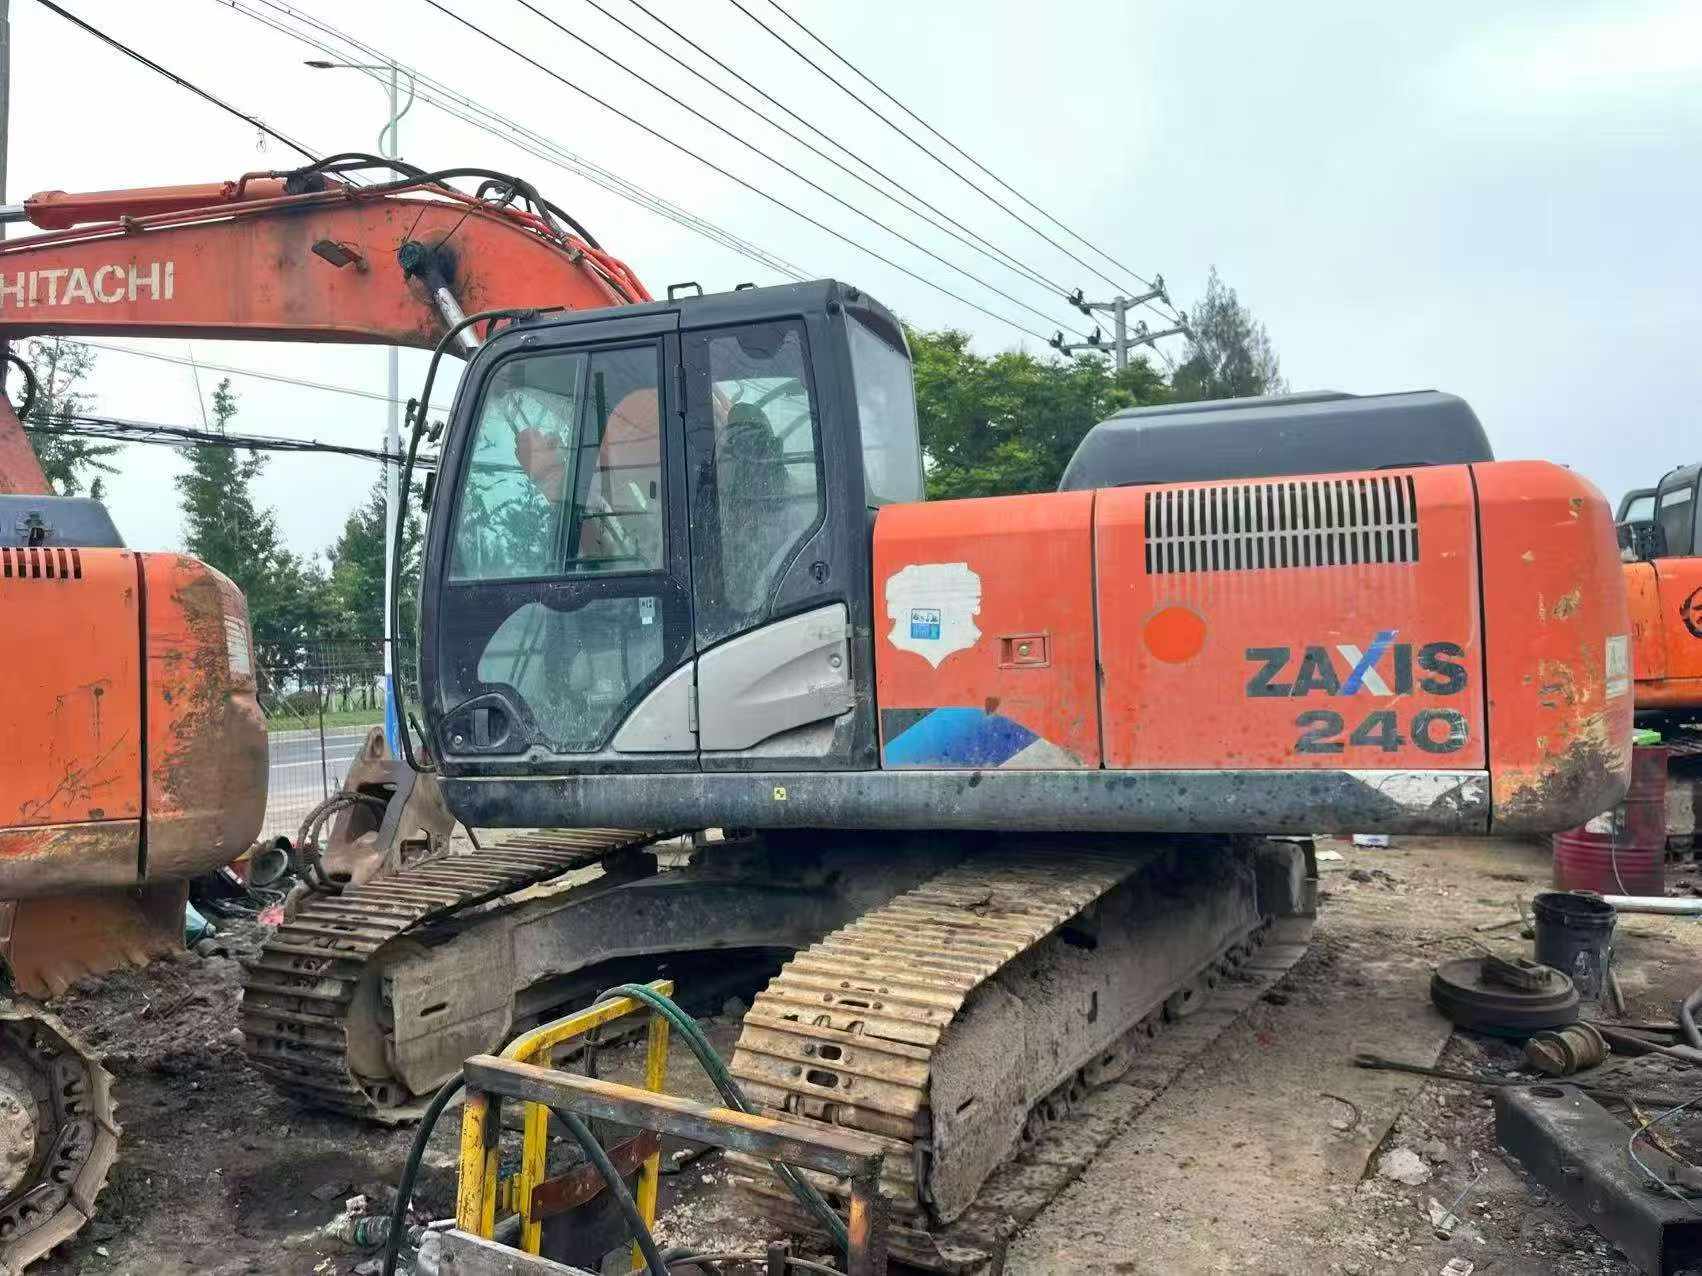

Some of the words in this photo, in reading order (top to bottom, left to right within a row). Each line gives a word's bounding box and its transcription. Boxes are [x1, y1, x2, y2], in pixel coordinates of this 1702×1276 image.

[0, 261, 174, 308] HITACHI
[1245, 630, 1468, 697] ZAXIS
[1295, 708, 1470, 754] 240
